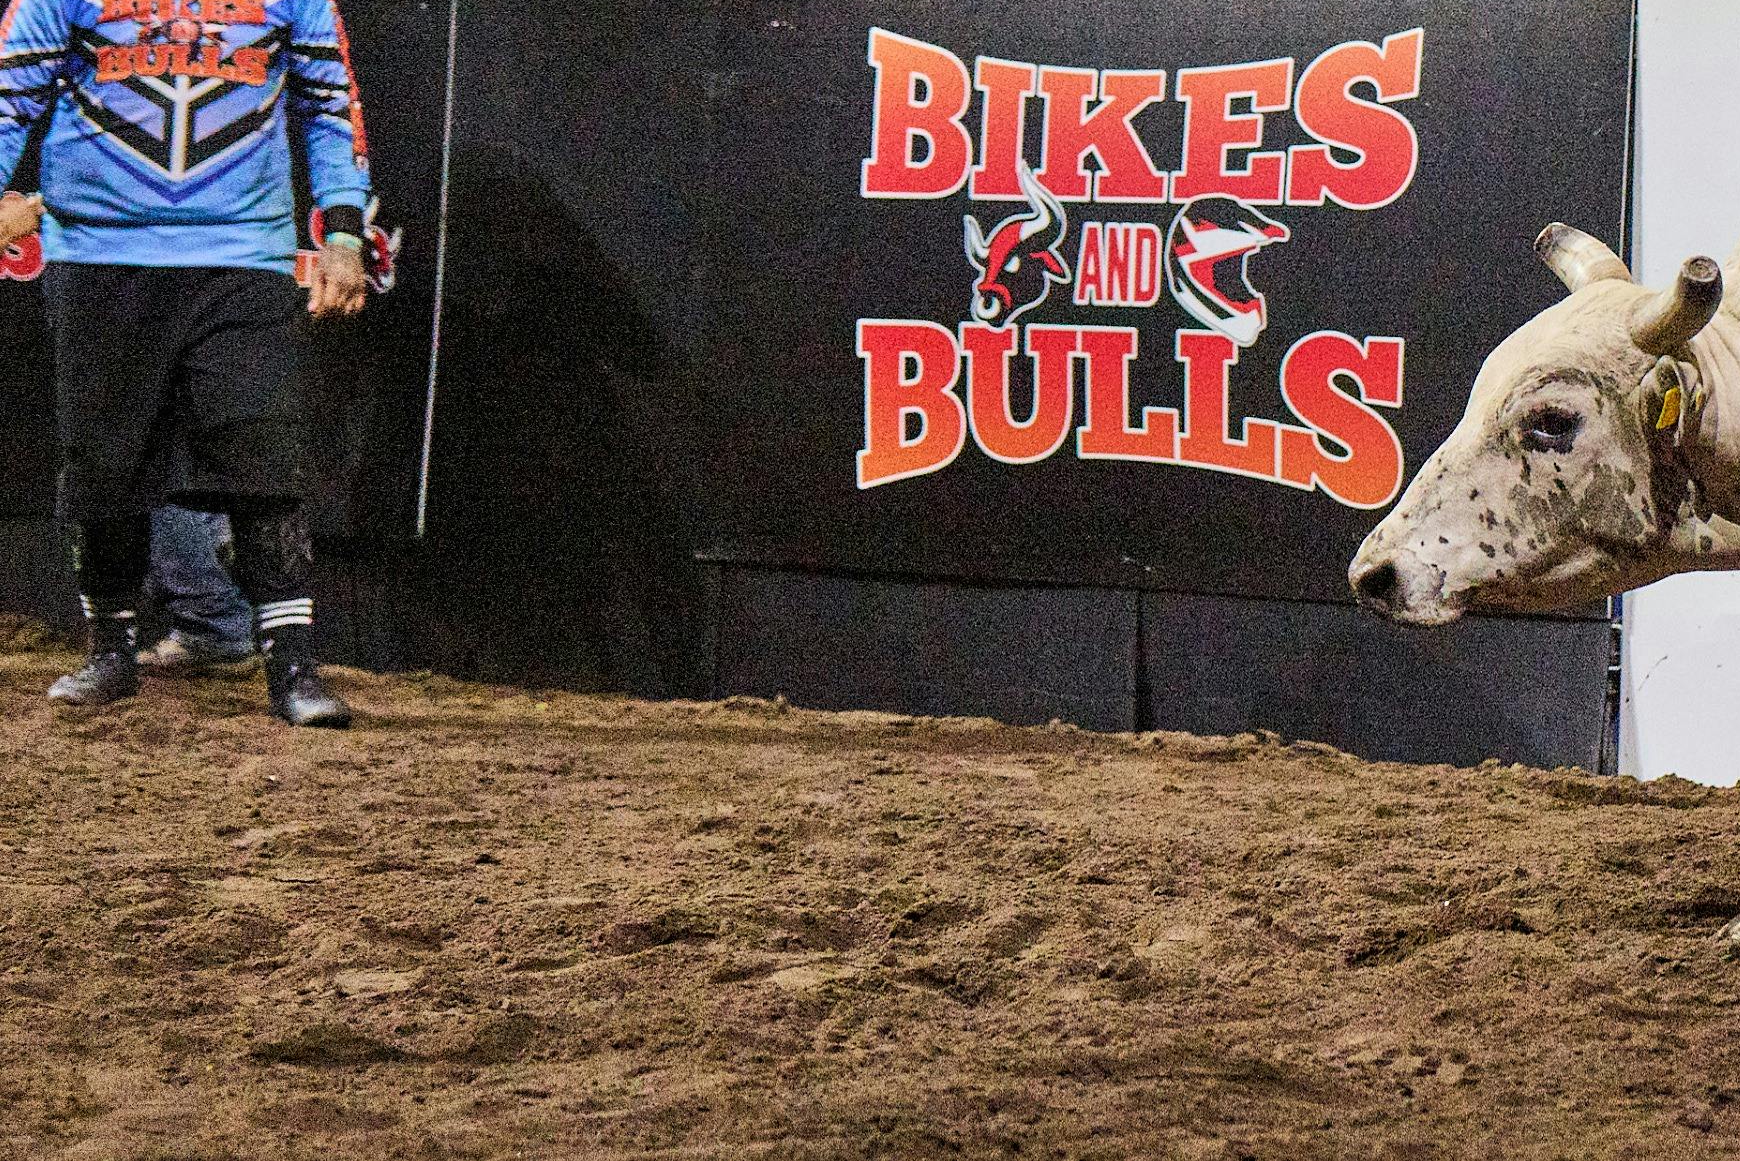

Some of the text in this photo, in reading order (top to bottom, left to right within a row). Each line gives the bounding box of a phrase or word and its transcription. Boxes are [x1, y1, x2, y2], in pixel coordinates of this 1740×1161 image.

[96, 45, 268, 86] BULLS
[861, 27, 1423, 210] BIKES
[1073, 221, 1162, 307] AND
[856, 319, 1405, 509] BULLS
